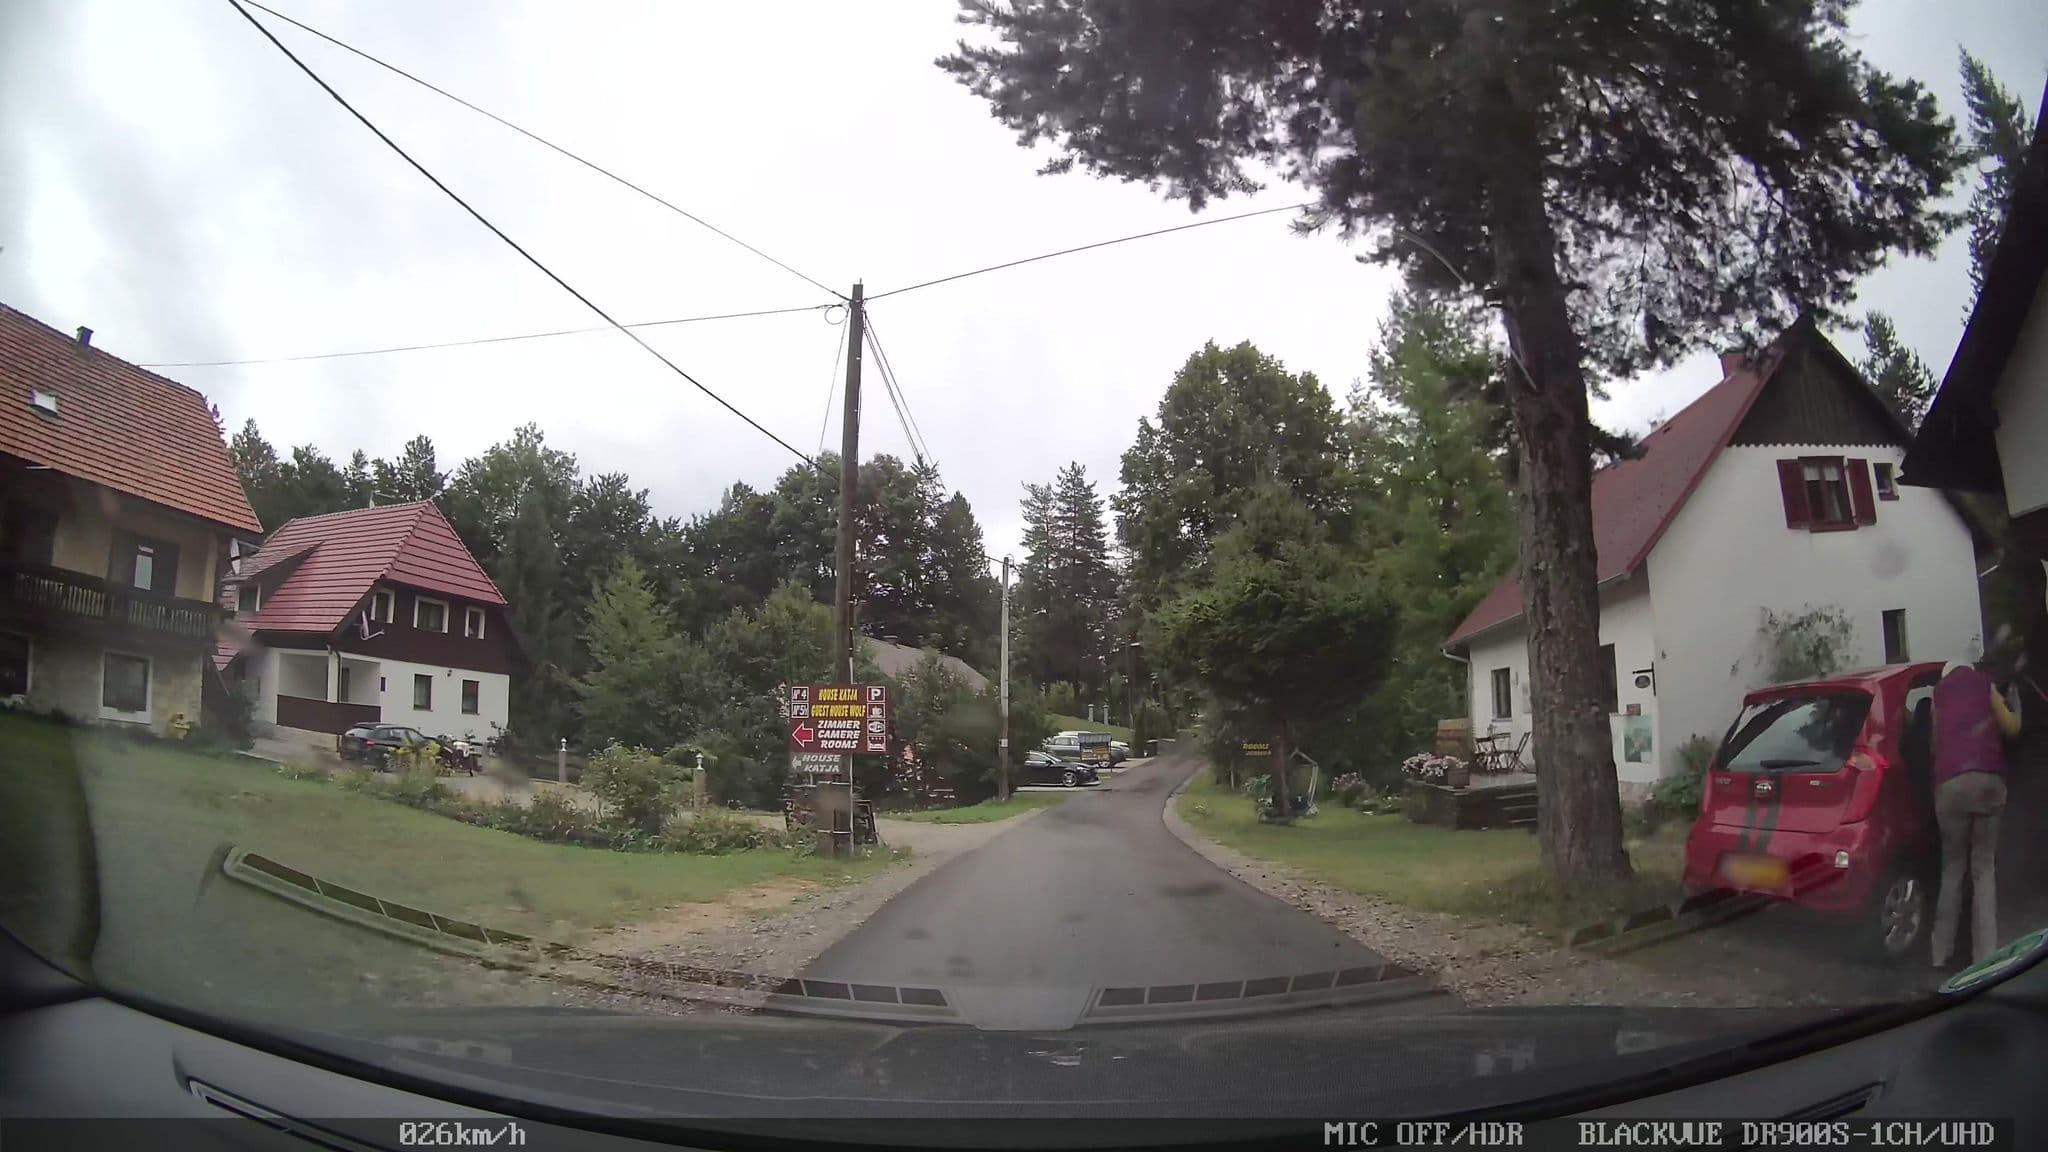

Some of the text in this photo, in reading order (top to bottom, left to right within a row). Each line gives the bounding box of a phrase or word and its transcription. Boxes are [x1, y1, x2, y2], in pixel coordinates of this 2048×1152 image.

[818, 688, 839, 701] HOUSE
[871, 688, 881, 700] P
[811, 704, 866, 717] GUEST HOUSE WOLF
[817, 720, 861, 729] ZIMMER
[817, 730, 861, 739] CAMERE
[820, 740, 859, 749] ROOMS
[802, 754, 841, 763] HOUSE
[804, 764, 840, 773] KATJA
